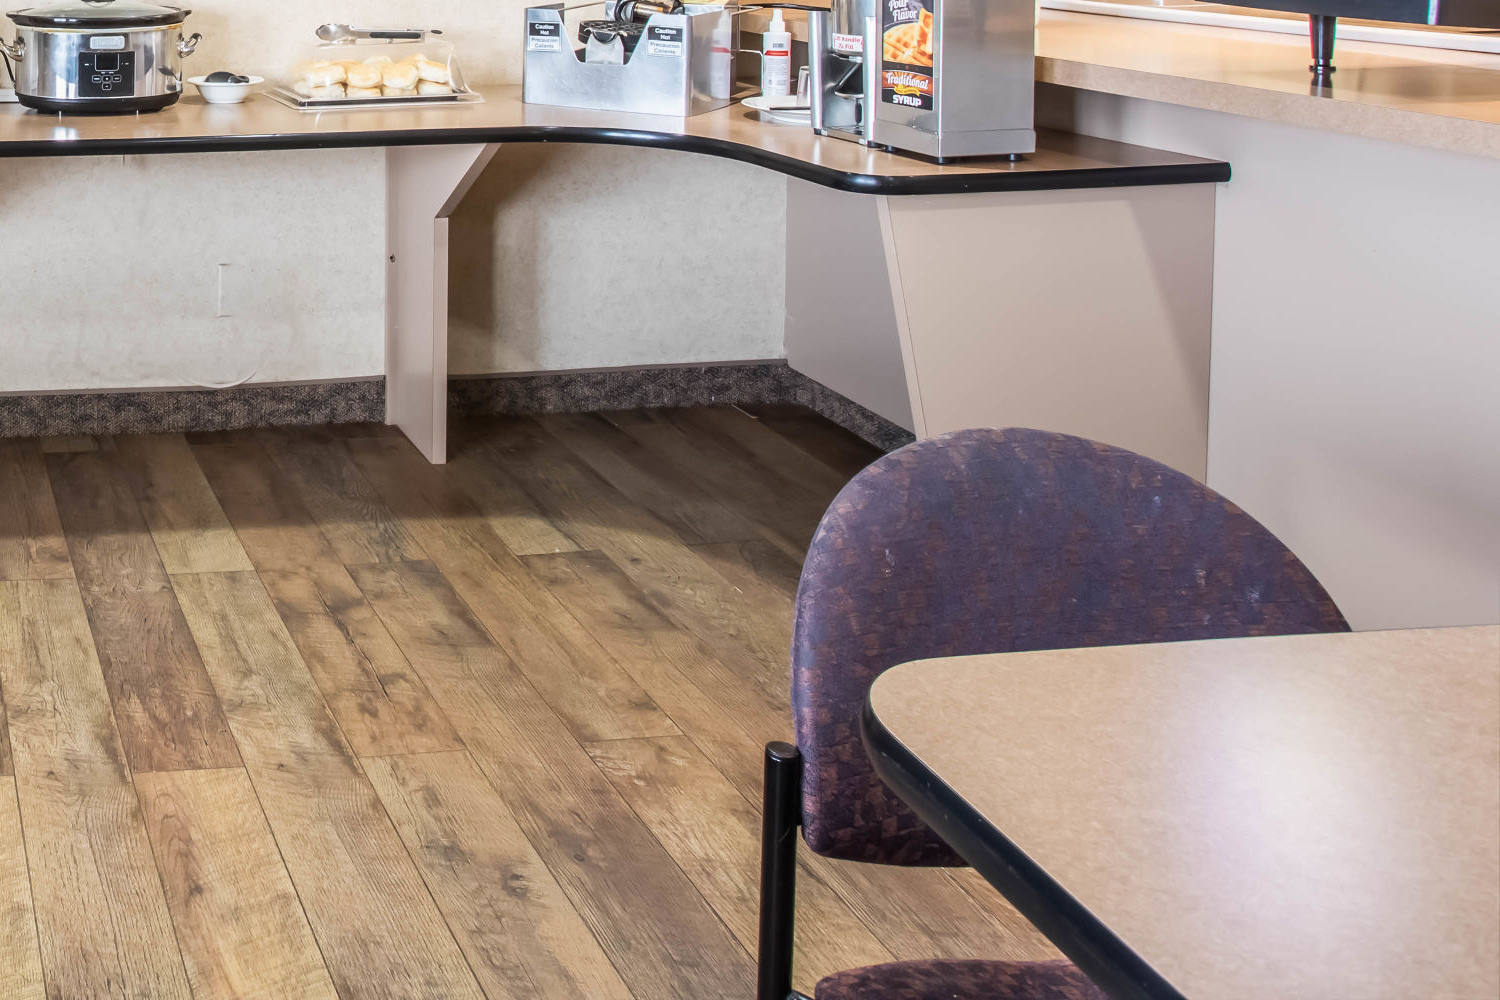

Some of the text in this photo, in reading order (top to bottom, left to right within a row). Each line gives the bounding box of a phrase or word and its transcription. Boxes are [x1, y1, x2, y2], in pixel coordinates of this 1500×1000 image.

[888, 0, 909, 12] Pour
[892, 9, 918, 22] Flavor
[654, 27, 677, 35] Caution
[886, 72, 929, 90] Traditional
[892, 94, 923, 107] SYRUP
